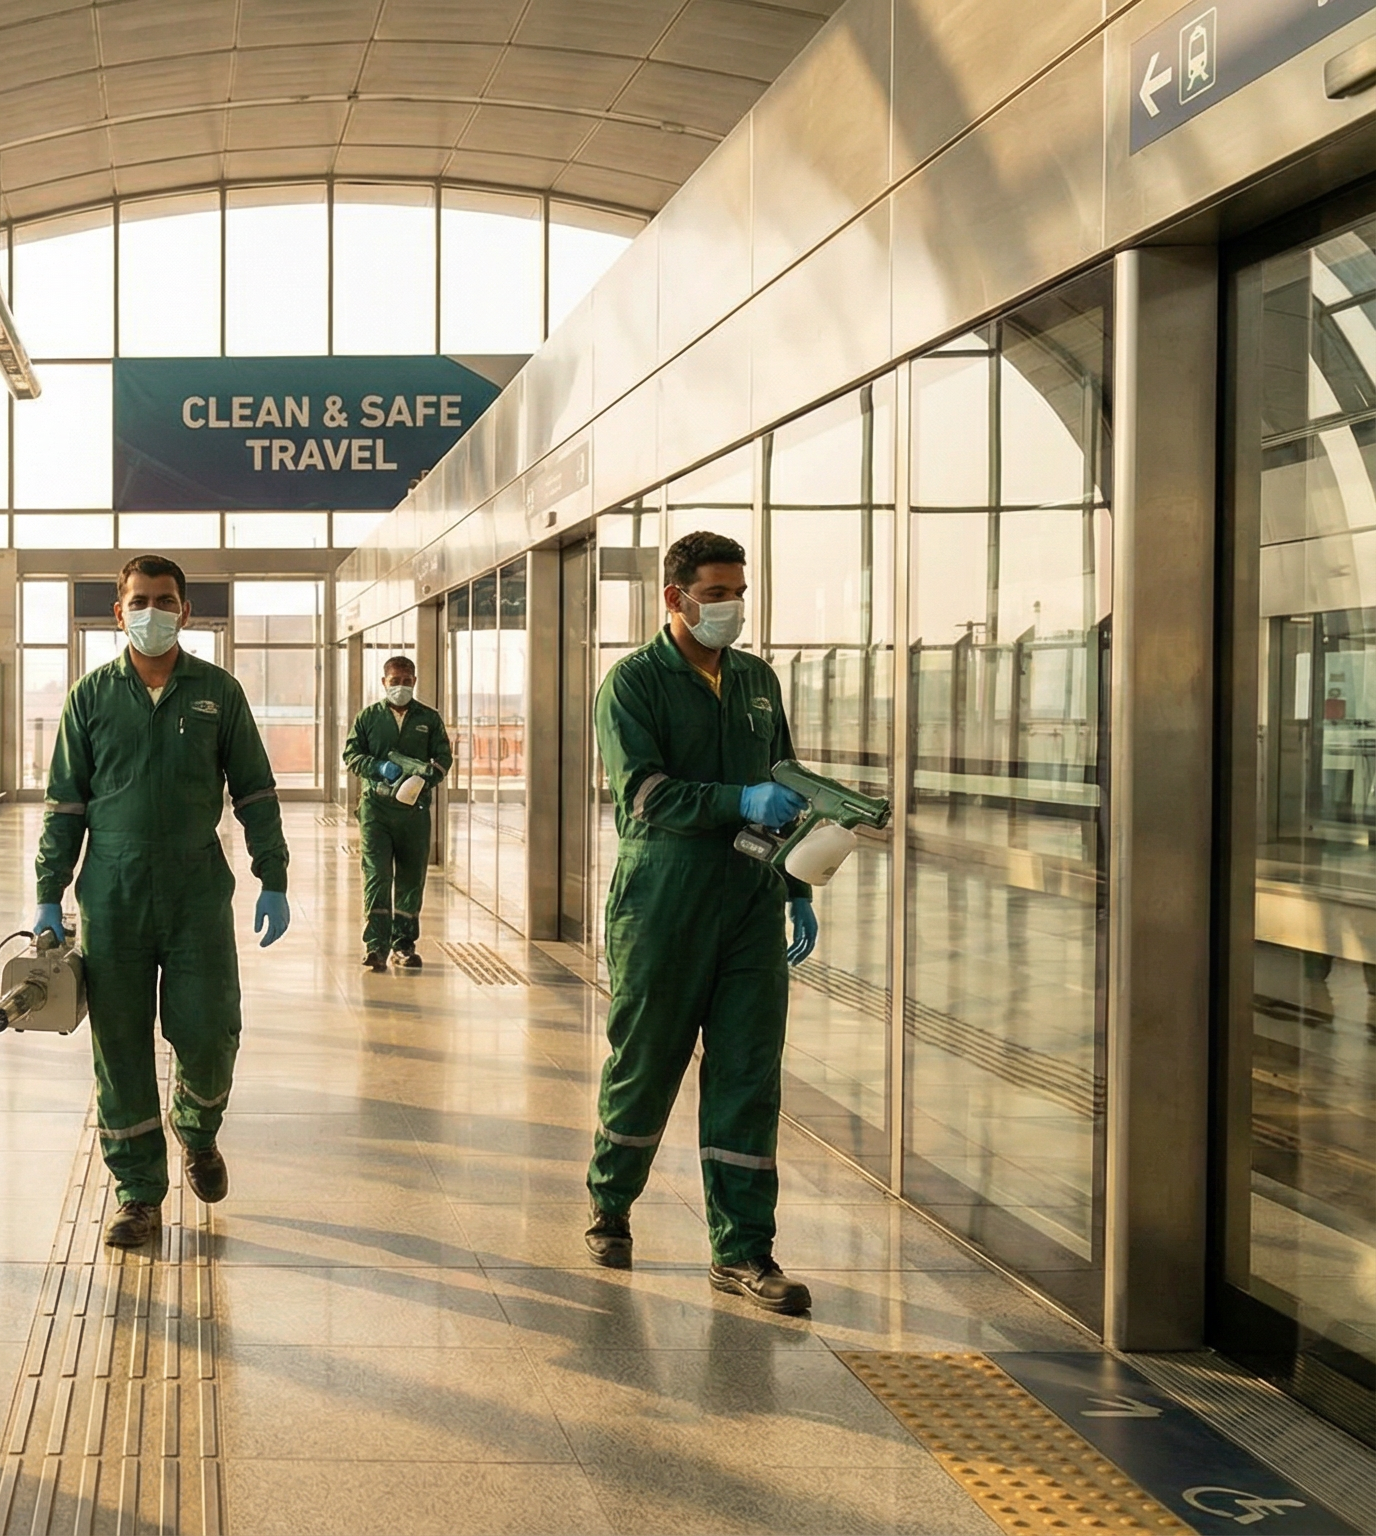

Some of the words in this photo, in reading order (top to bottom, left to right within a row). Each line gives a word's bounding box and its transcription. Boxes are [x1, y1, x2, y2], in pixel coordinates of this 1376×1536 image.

[182, 395, 310, 429] CLEAN
[322, 395, 349, 429] &
[360, 395, 463, 428] SAFE
[245, 438, 399, 471] TRAVEL
